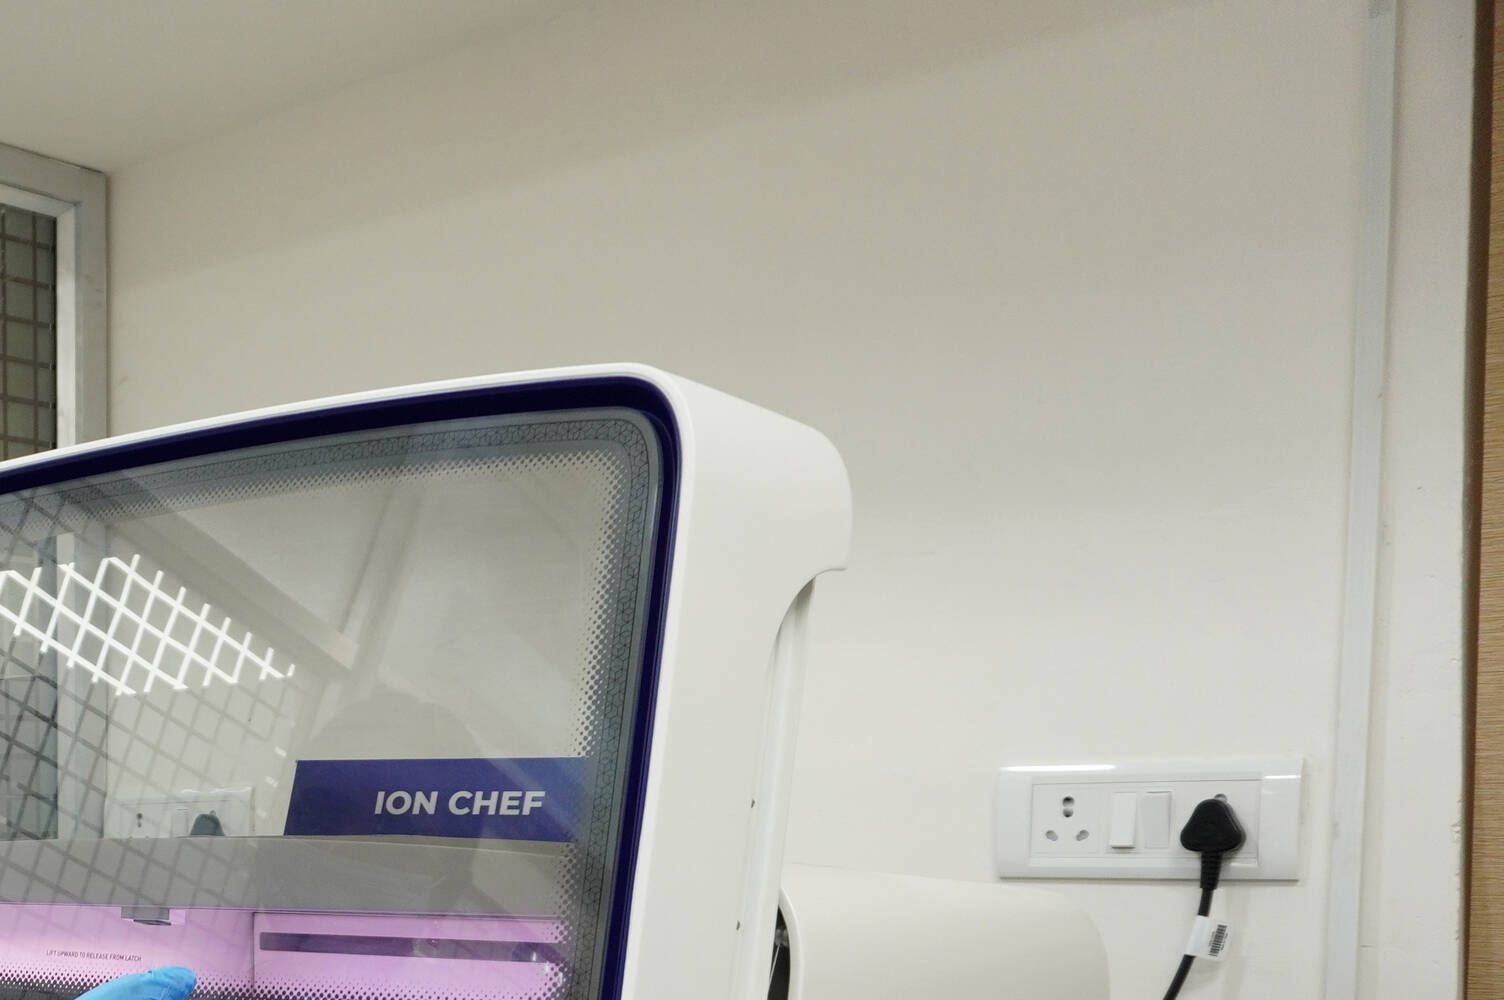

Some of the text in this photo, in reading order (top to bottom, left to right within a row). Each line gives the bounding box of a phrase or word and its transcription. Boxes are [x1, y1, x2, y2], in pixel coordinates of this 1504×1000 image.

[374, 790, 546, 816] ION CHEF
[46, 949, 57, 957] LIFT
[57, 950, 78, 958] UPWARD
[86, 951, 108, 960] RELEASE
